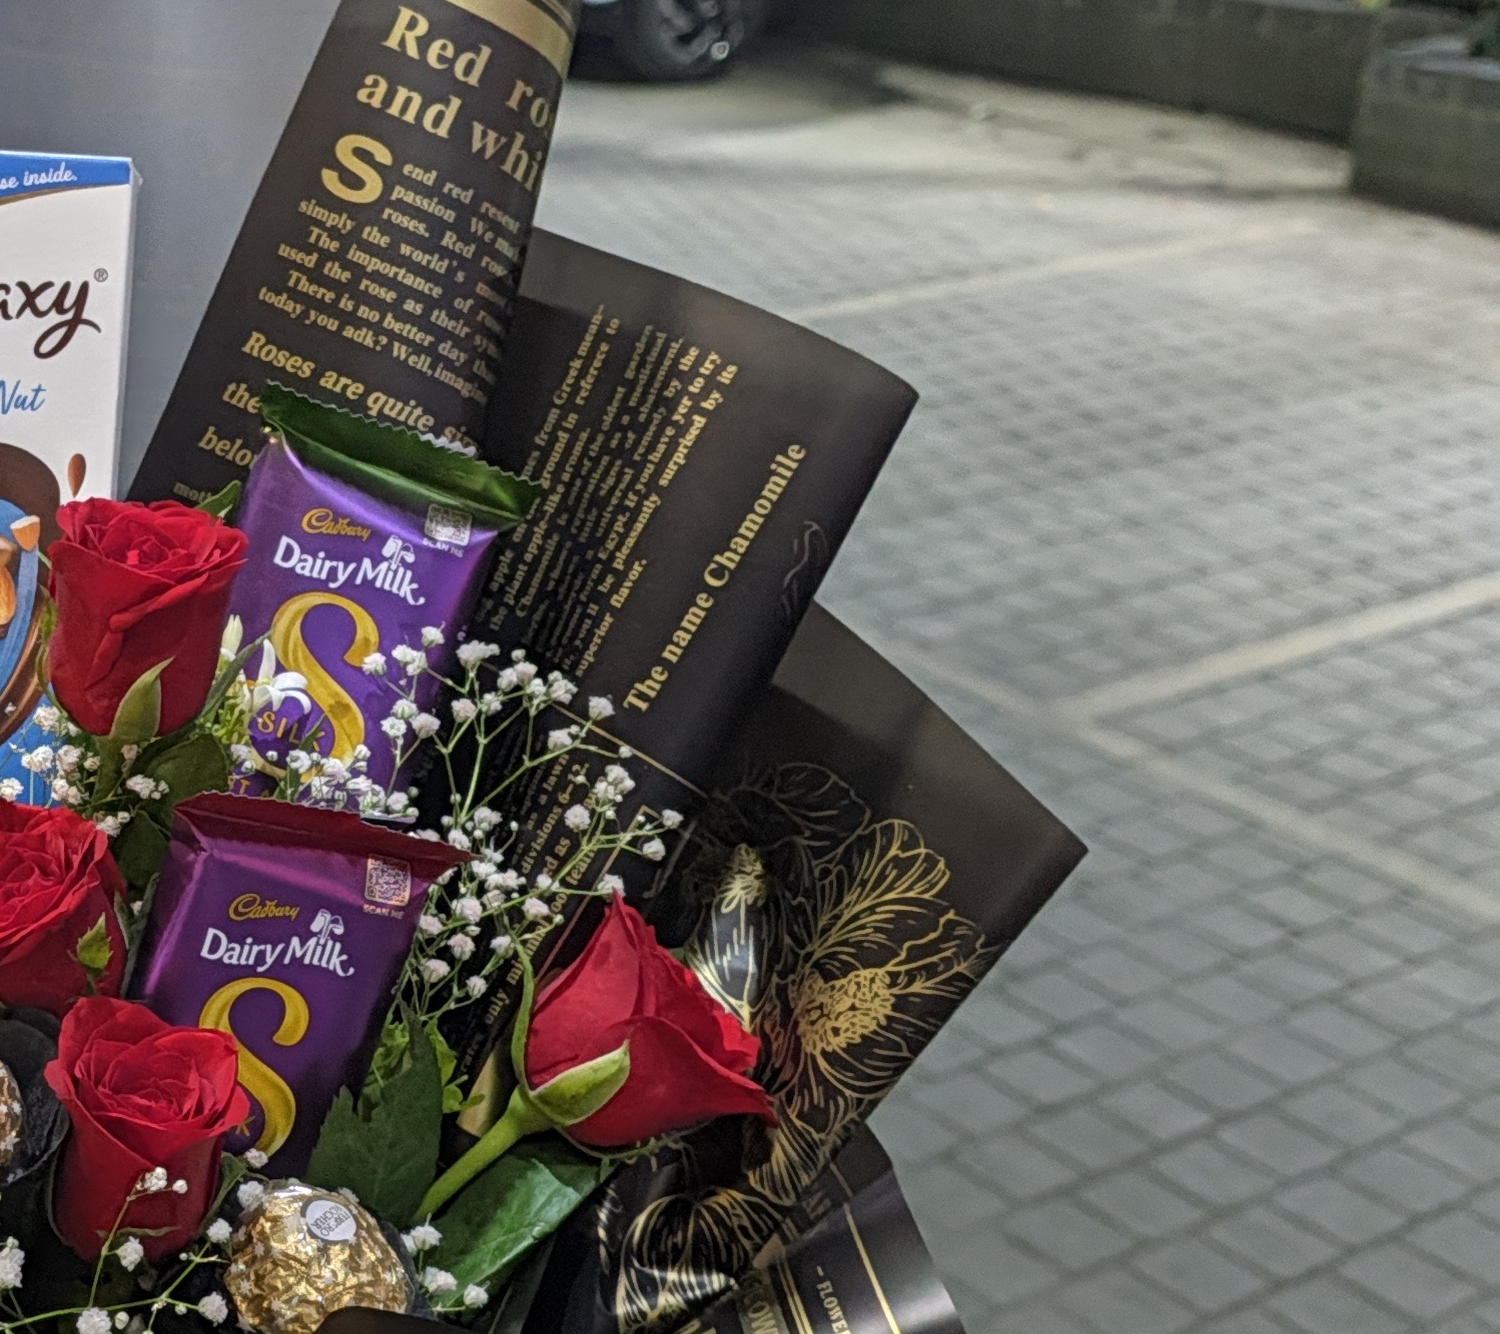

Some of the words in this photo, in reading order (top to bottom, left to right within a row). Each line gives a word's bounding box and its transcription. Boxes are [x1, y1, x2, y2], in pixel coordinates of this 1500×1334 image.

[381, 5, 491, 86] Red
[356, 74, 461, 138] and
[23, 163, 77, 187] inside.
[389, 184, 455, 223] passion
[441, 181, 474, 204] red
[298, 198, 355, 234] simply
[361, 225, 390, 247] the
[381, 207, 430, 237] roses.
[439, 230, 476, 259] Red
[277, 243, 319, 268] used
[322, 261, 351, 283] the
[358, 277, 397, 302] rose
[402, 299, 424, 315] as
[429, 308, 471, 338] their
[307, 225, 339, 252] The
[346, 243, 442, 298] importance
[454, 297, 474, 313] of
[258, 286, 305, 318] today
[304, 309, 339, 331] you
[341, 325, 388, 351] adk?
[286, 269, 336, 303] There
[337, 292, 355, 311] is
[355, 304, 379, 321] no
[381, 311, 435, 346] better
[437, 339, 468, 366] day
[624, 324, 660, 379] garden
[222, 382, 263, 413] the
[241, 330, 315, 377] Roses
[318, 370, 364, 399] are
[366, 391, 434, 441] quite
[534, 407, 561, 446] from
[553, 358, 583, 404] Greek
[627, 331, 667, 406] medicinal
[561, 412, 578, 429] in
[595, 467, 634, 537] universal
[662, 377, 682, 397] by
[677, 346, 699, 371] the
[597, 511, 630, 560] Egypt.
[634, 462, 655, 494] you
[646, 426, 675, 462] have
[687, 377, 703, 392] to
[698, 351, 721, 374] try
[611, 492, 661, 570] pleasantly
[658, 414, 707, 487] surprised
[699, 389, 723, 409] by
[716, 365, 737, 384] its
[301, 508, 371, 543] Cadbury
[503, 563, 528, 605] plant
[561, 427, 591, 482] aroma.
[273, 534, 358, 588] Dairy
[355, 556, 426, 606] Milk
[622, 665, 668, 711] The
[661, 592, 713, 663] name
[703, 444, 805, 587] Chamomile
[575, 611, 614, 677] superior
[610, 558, 647, 608] flavor.
[228, 893, 301, 922] Cadbury
[200, 927, 286, 973] Dairy
[282, 934, 355, 977] Milk
[485, 988, 510, 1024] only
